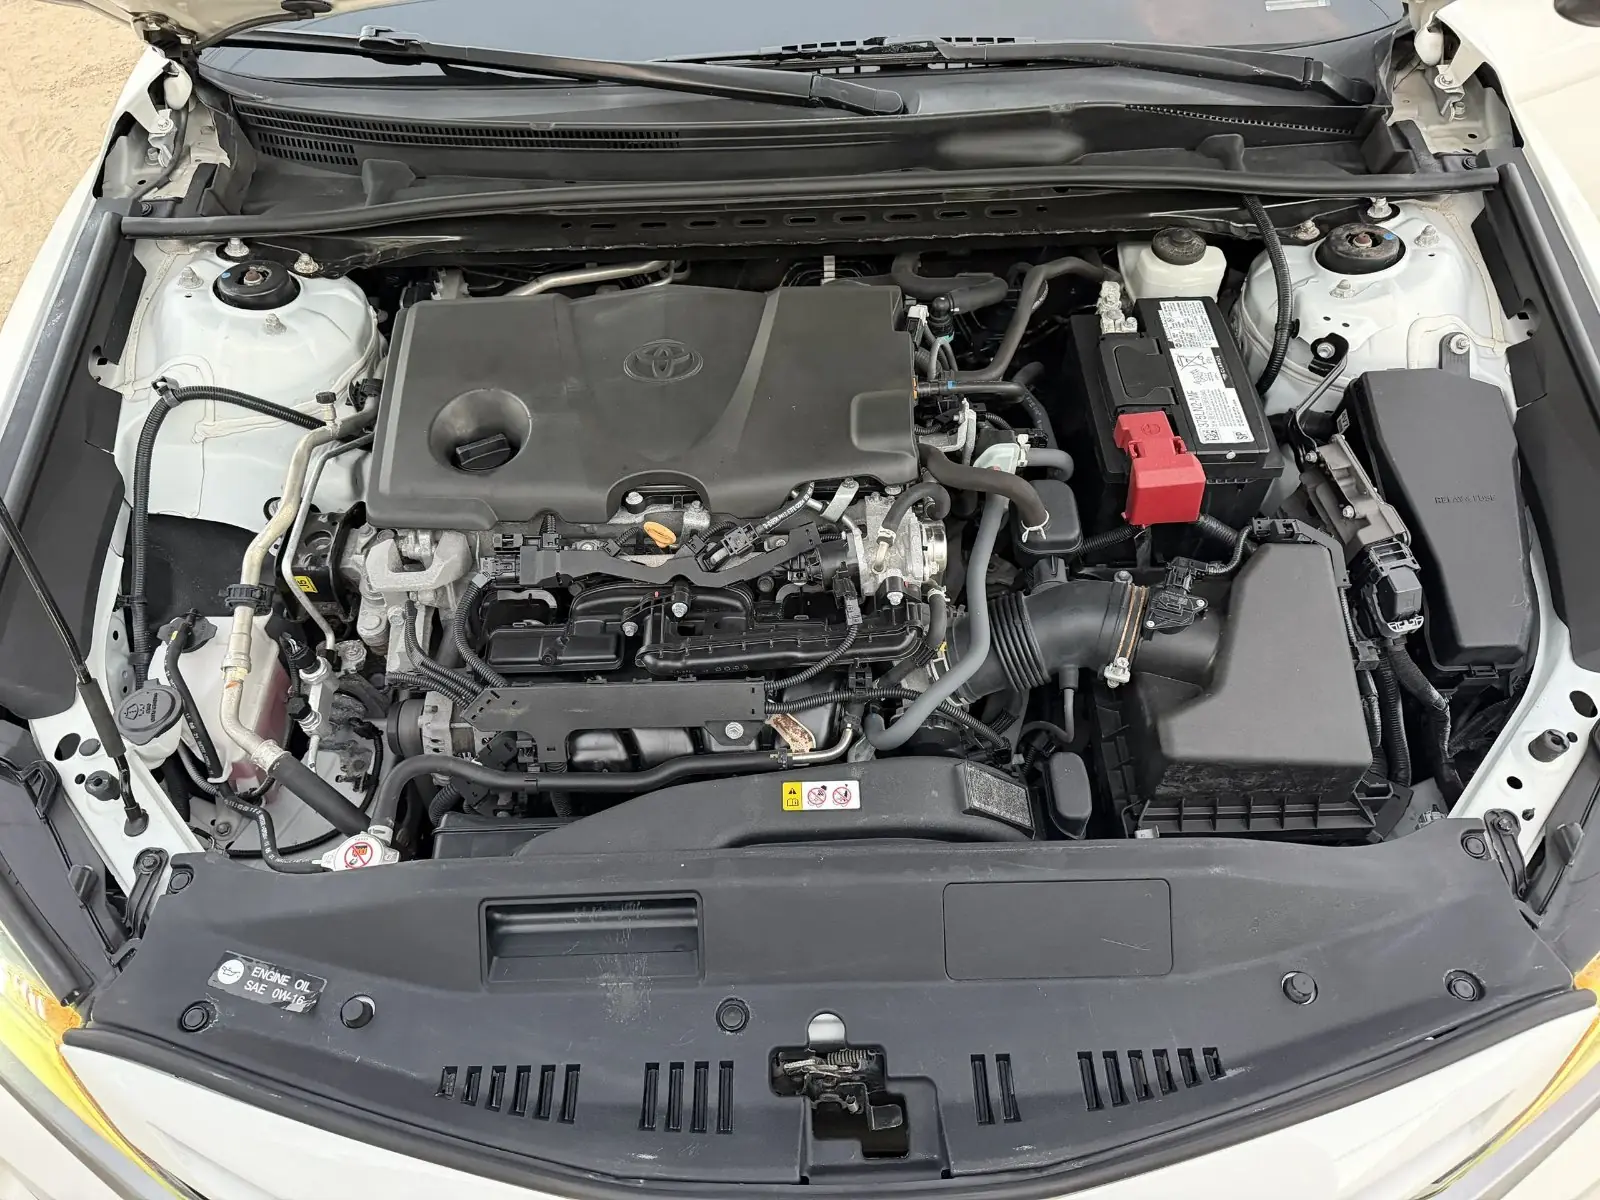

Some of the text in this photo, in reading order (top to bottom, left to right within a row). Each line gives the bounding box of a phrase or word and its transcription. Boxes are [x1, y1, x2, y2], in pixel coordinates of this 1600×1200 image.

[250, 966, 312, 993] ENGINE OIL
[243, 980, 306, 1006] SAE 0W-16
